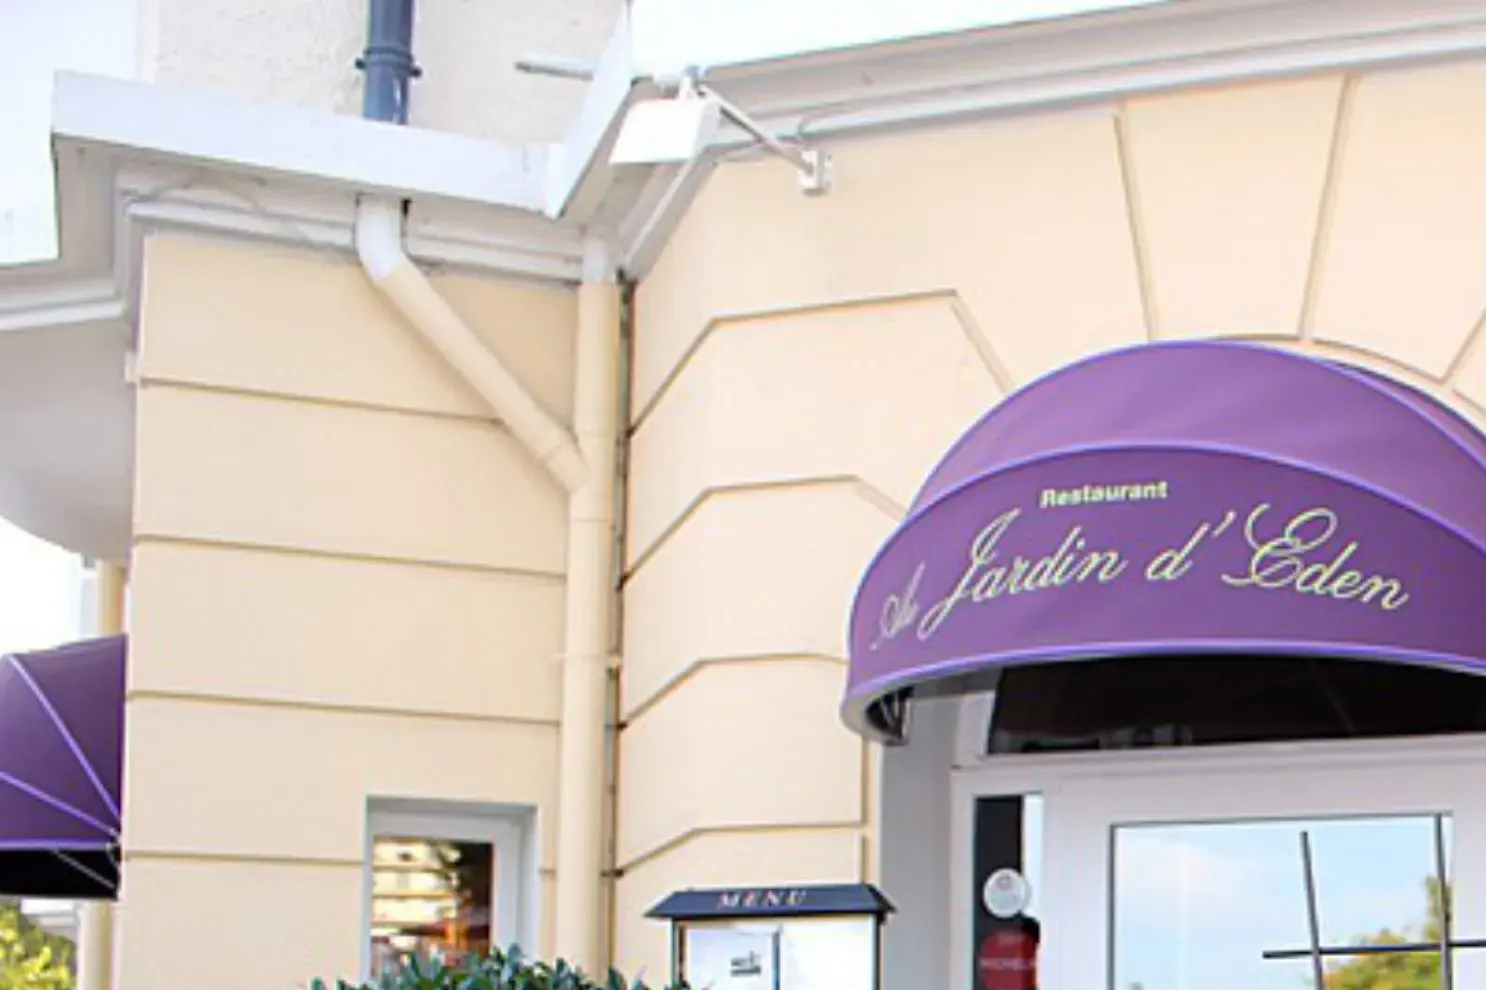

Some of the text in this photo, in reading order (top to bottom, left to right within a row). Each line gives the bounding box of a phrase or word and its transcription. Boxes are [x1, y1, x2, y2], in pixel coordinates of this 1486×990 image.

[1040, 480, 1168, 508] Restaurant
[916, 508, 1126, 641] Jardin
[717, 890, 807, 909] MENU
